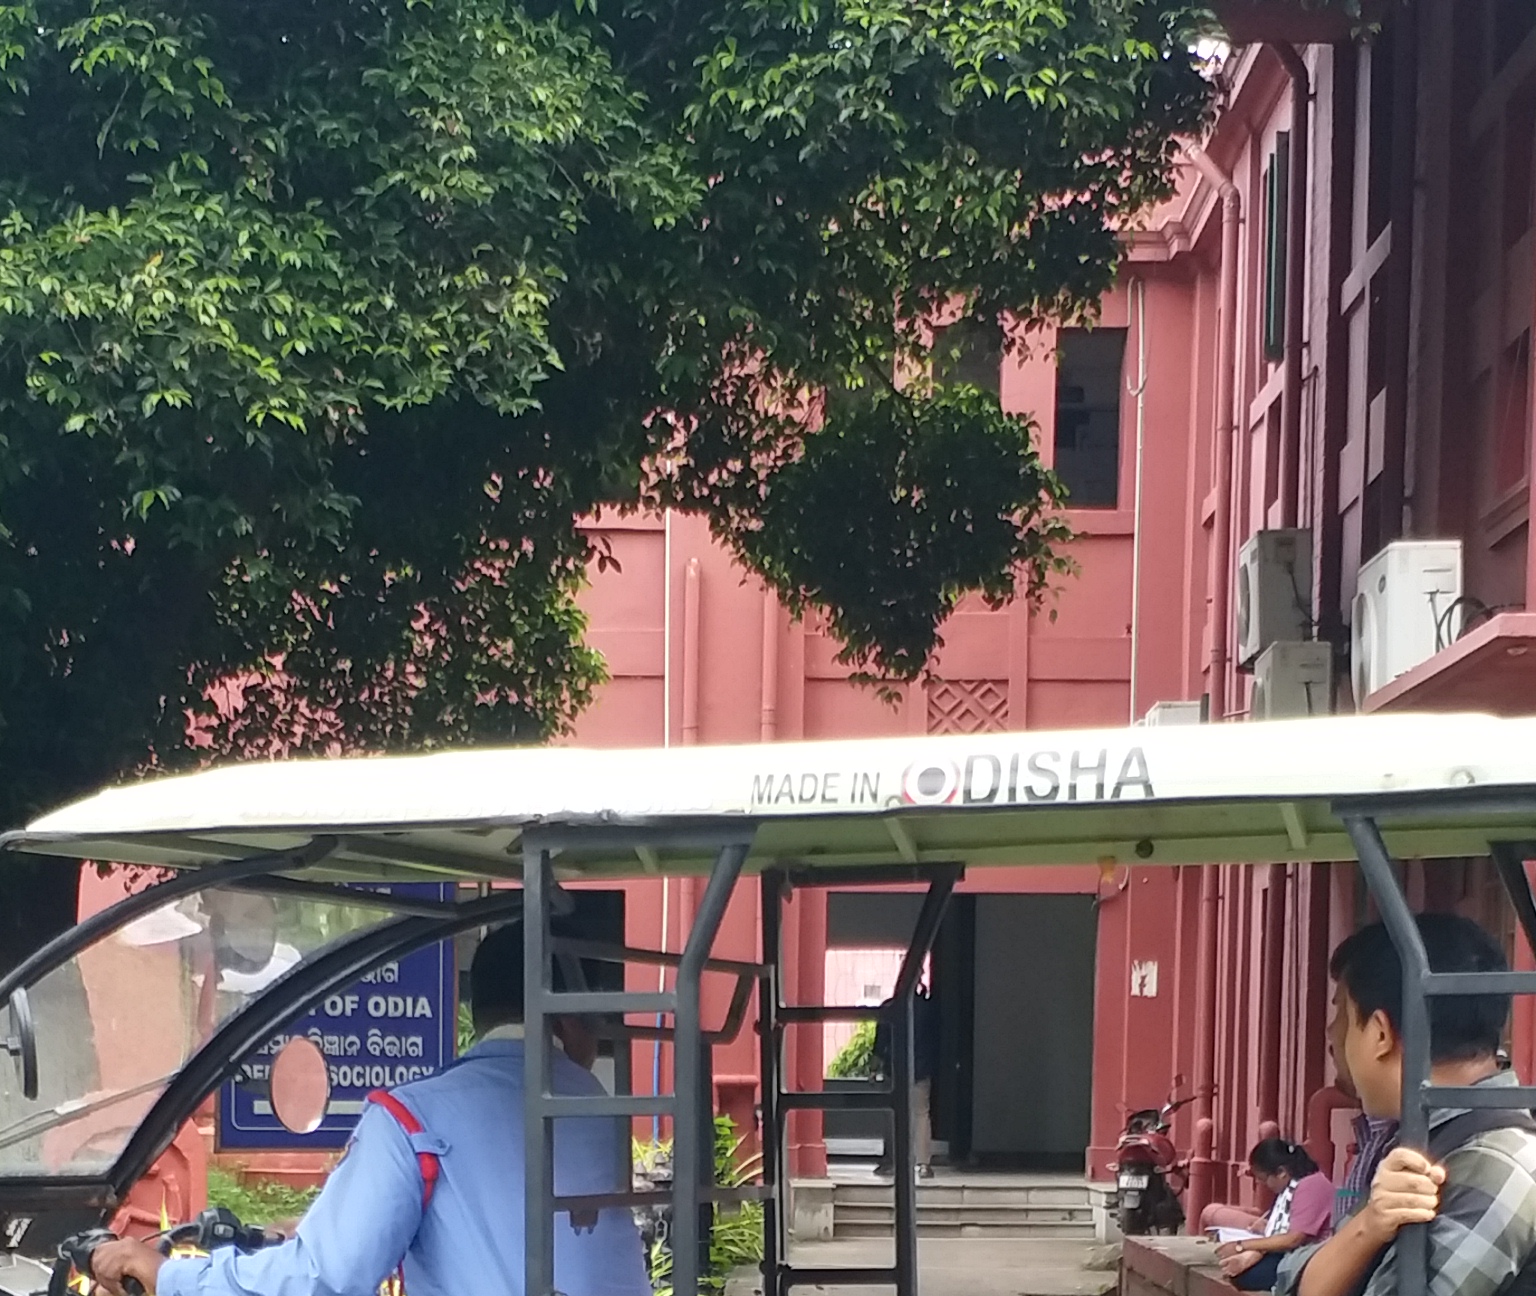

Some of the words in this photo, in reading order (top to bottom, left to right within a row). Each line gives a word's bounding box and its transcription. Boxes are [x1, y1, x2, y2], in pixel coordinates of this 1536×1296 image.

[751, 773, 841, 805] MADE
[851, 772, 880, 804] IN
[324, 996, 360, 1018] OF
[367, 996, 433, 1018] ODIA
[366, 1028, 423, 1058] ବିଭାଗ
